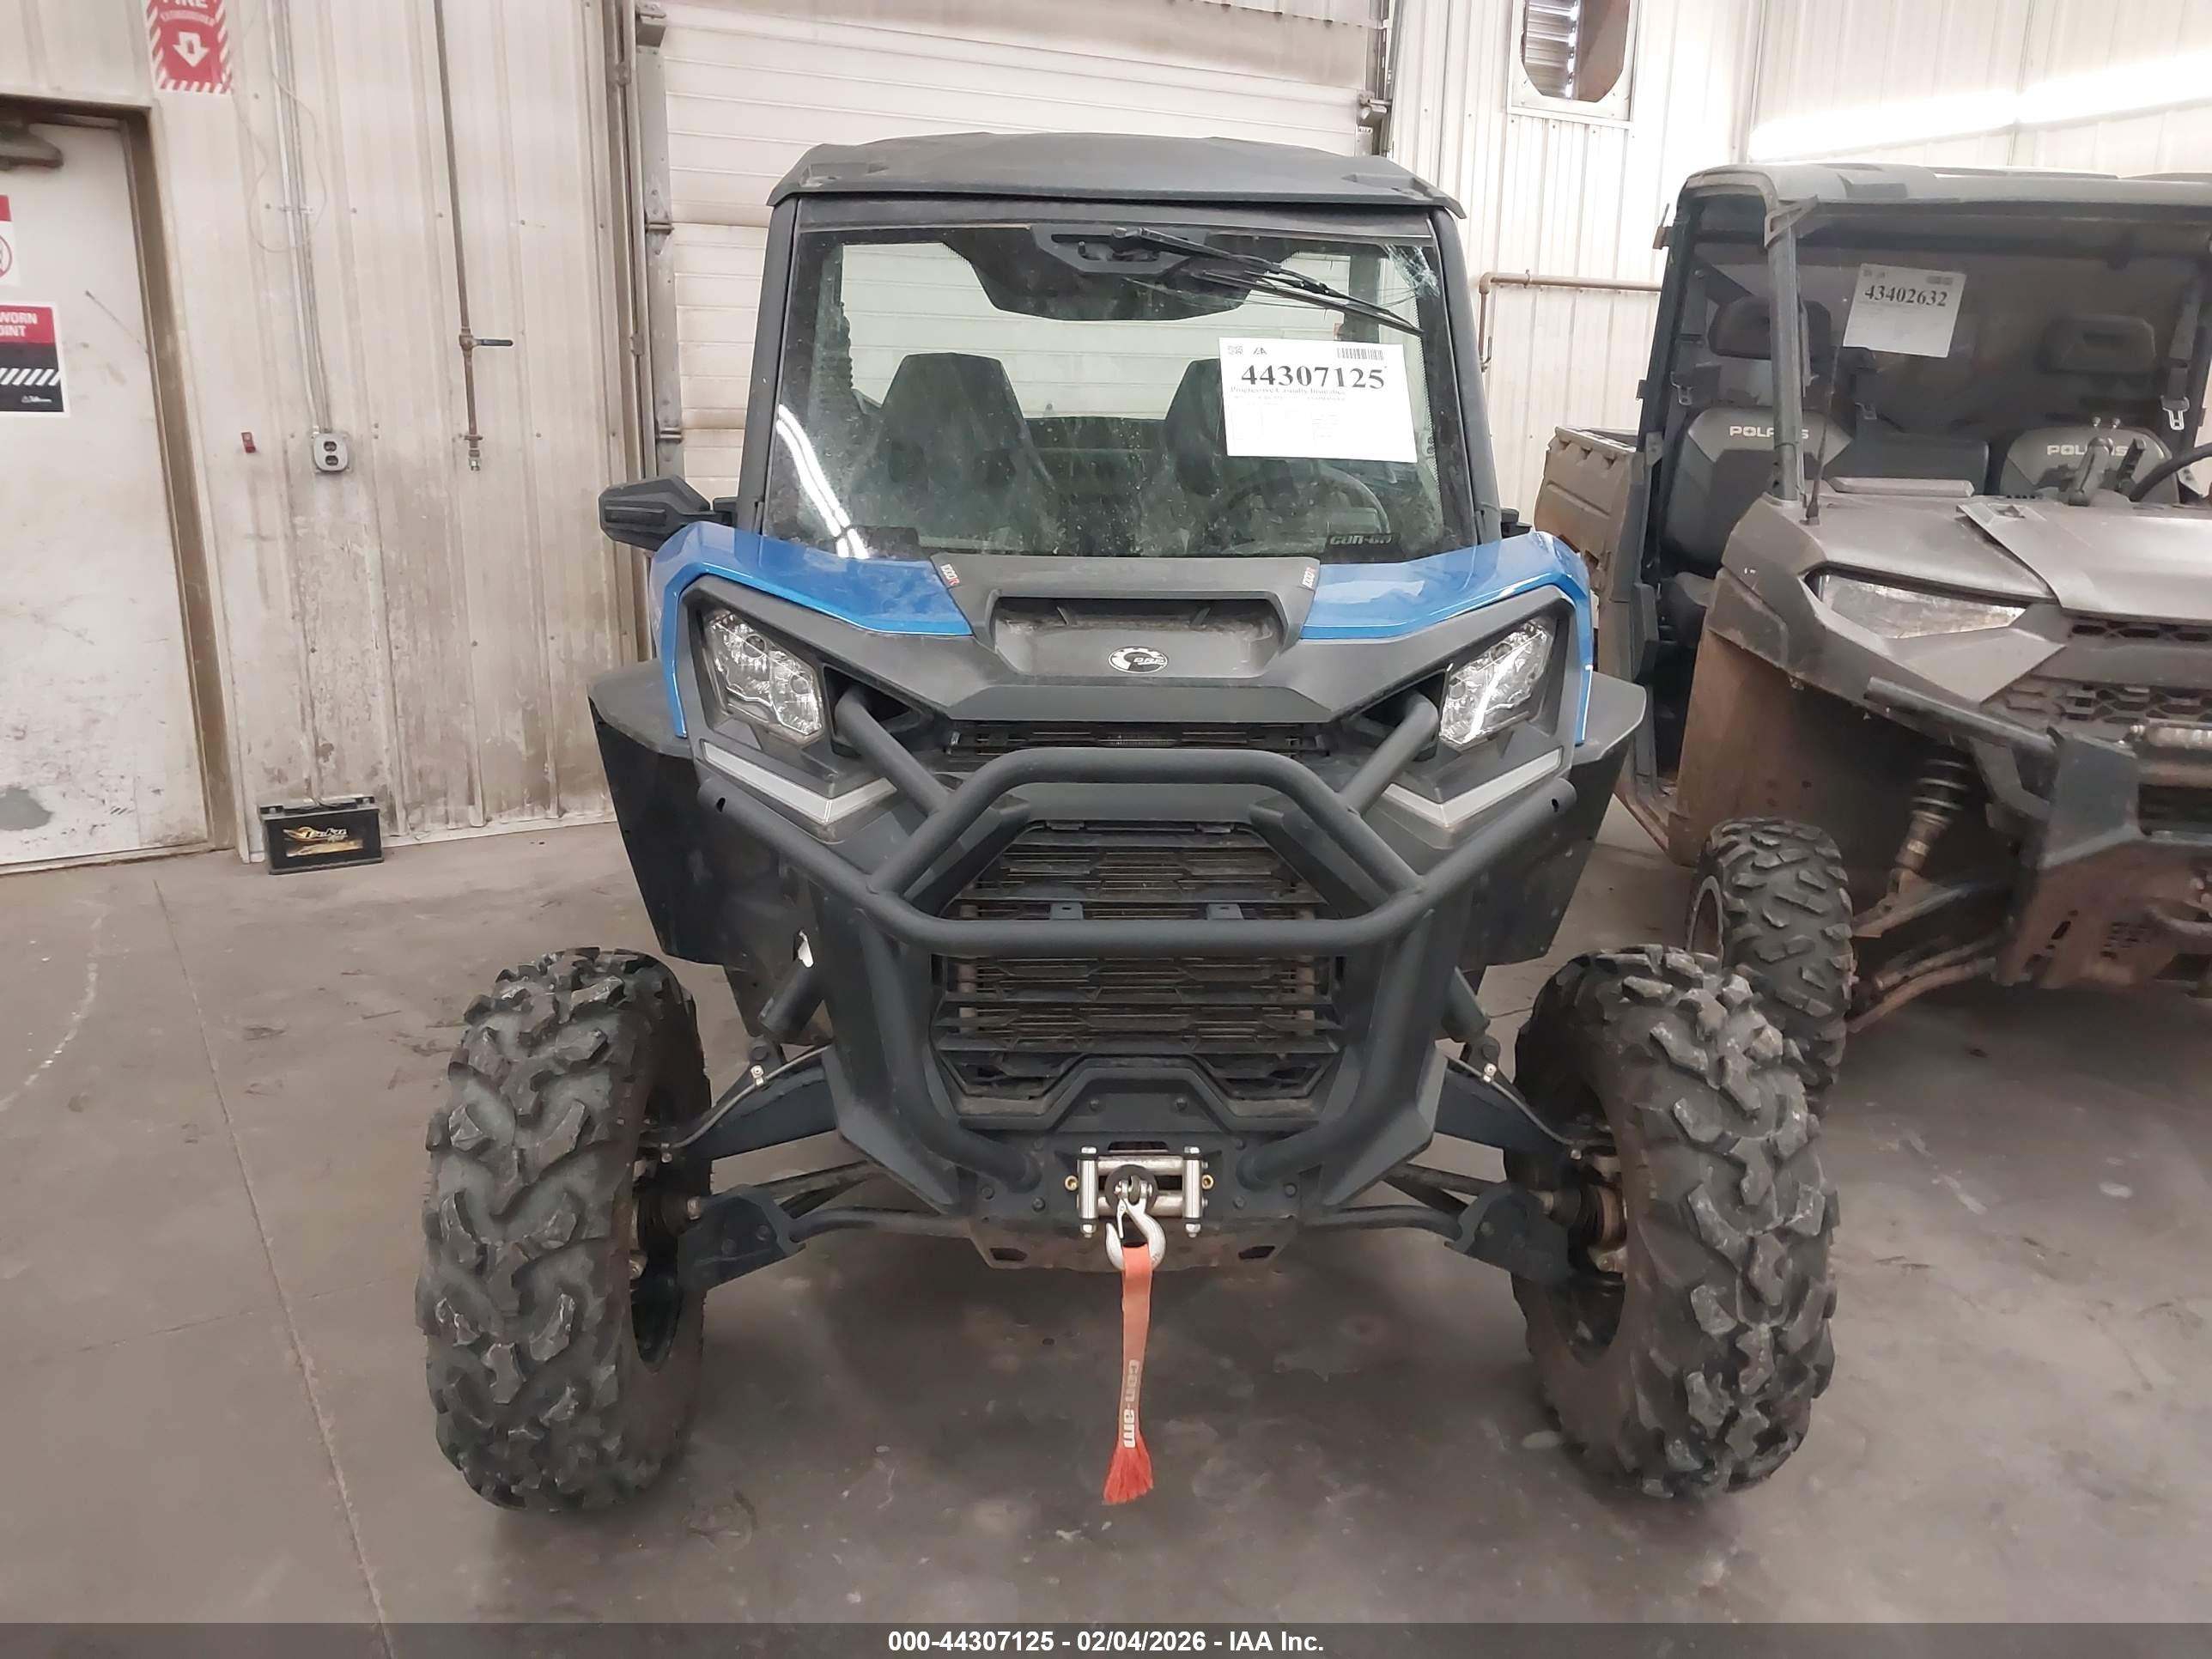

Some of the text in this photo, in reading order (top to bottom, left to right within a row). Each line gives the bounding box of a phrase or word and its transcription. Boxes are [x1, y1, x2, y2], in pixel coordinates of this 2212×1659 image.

[1864, 284, 1948, 307] 43402632
[0, 325, 27, 337] OINT
[1241, 365, 1384, 389] 44307125
